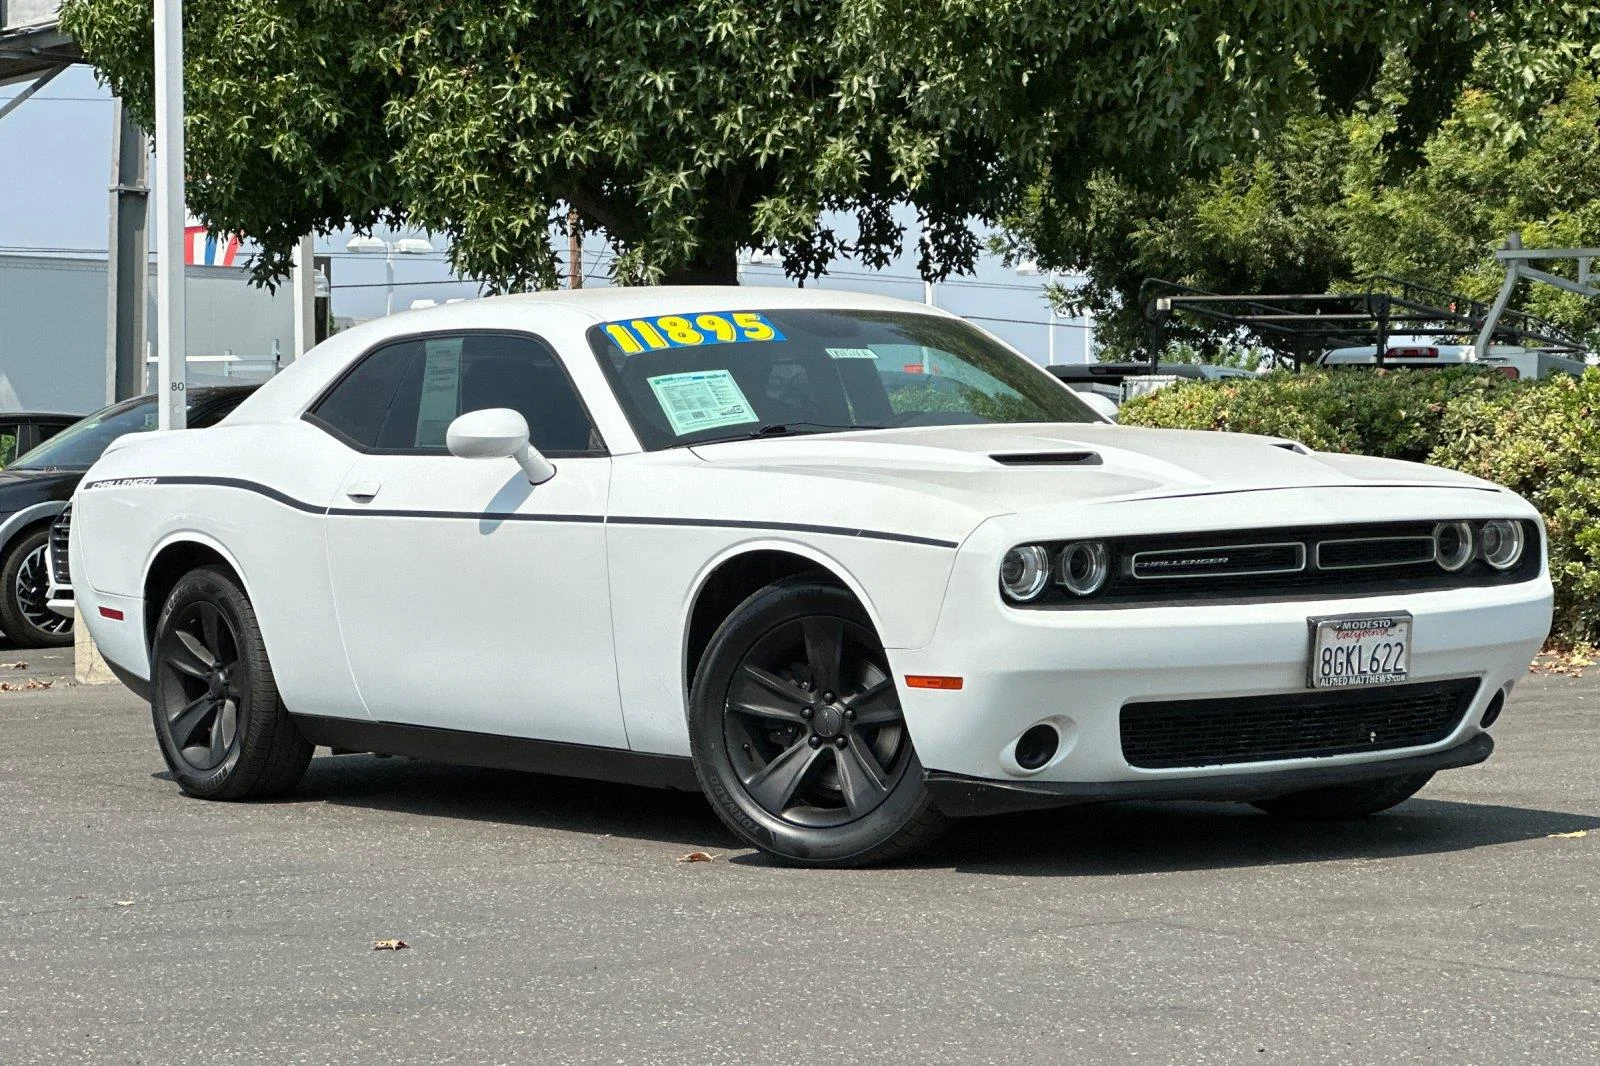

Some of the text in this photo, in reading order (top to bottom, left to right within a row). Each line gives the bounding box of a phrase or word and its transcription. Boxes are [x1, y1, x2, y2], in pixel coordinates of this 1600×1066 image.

[606, 313, 775, 356] 11895
[171, 382, 184, 391] 80
[92, 478, 157, 489] CHALLENGER
[1135, 557, 1229, 567] CHALLENGER
[1342, 620, 1391, 630] MODESTO
[1336, 628, 1394, 643] California
[1321, 642, 1404, 677] 8GKL622
[1320, 676, 1348, 689] ALFRED
